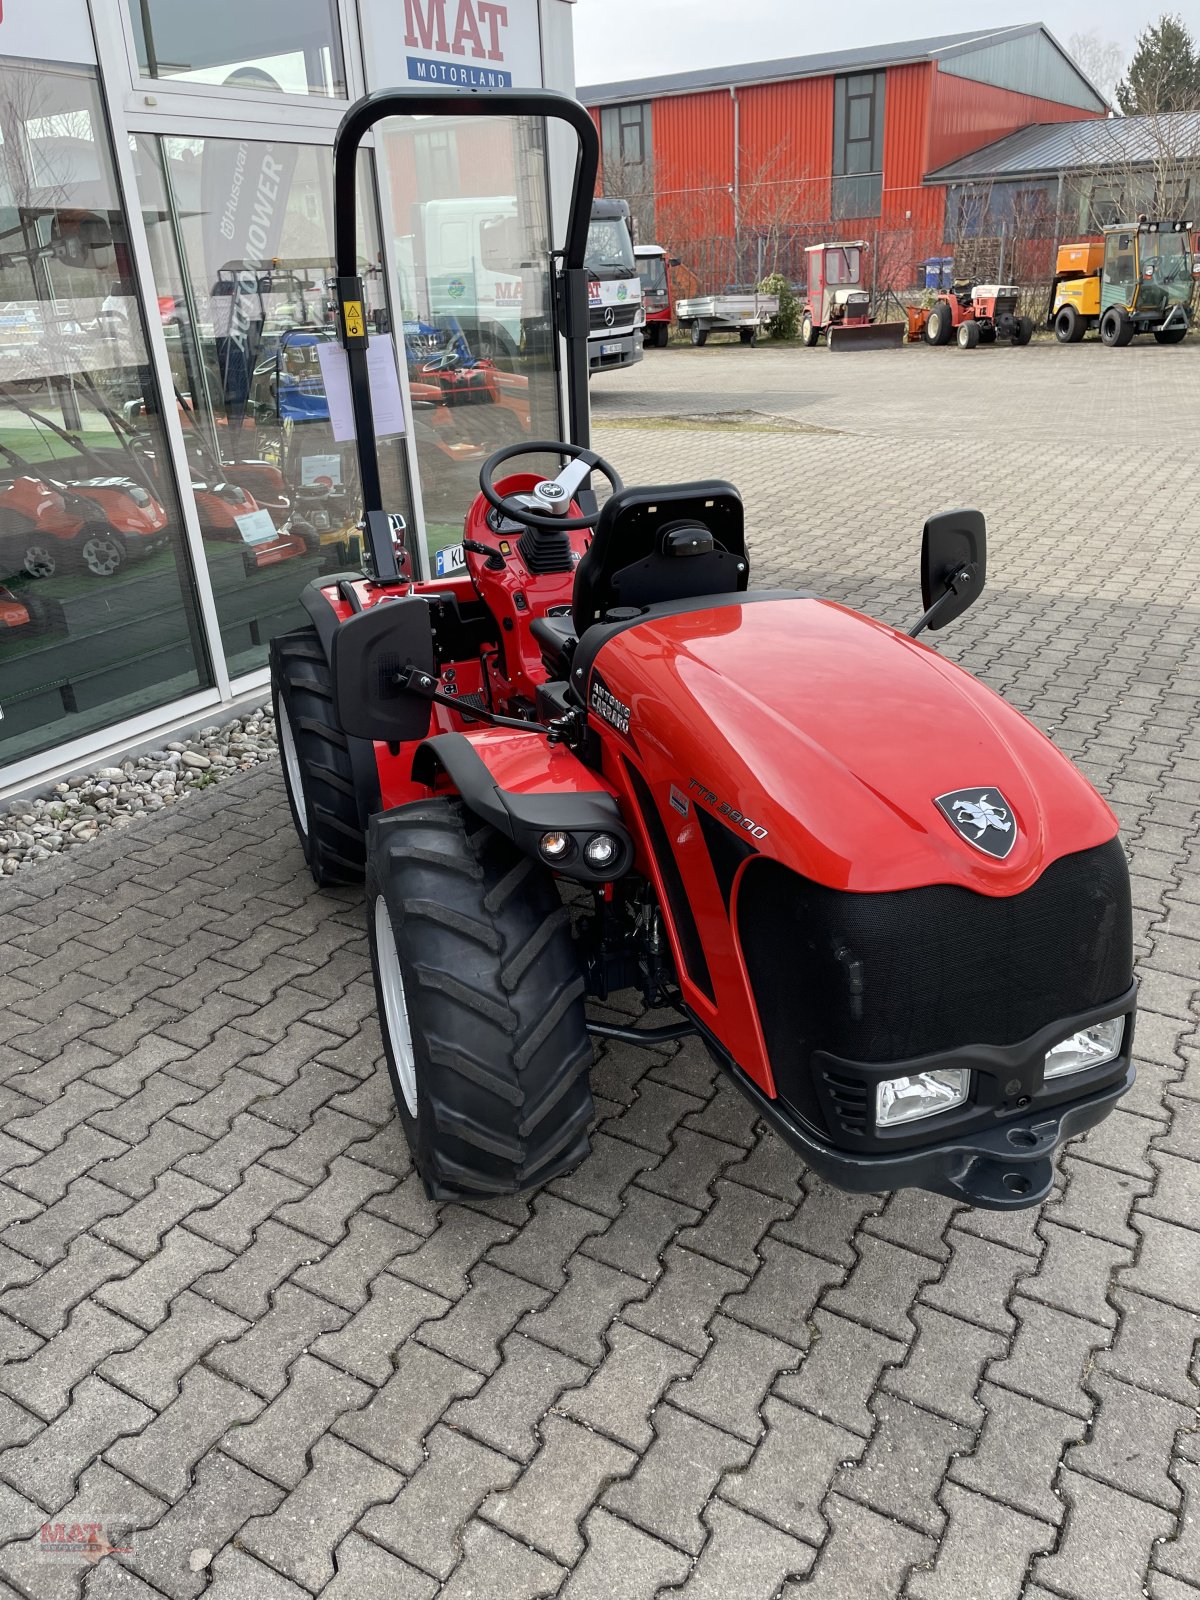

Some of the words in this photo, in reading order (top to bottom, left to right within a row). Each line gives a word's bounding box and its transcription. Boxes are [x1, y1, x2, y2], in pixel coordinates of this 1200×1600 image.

[404, 0, 508, 61] MAT
[417, 62, 504, 88] MOTORLAND
[591, 693, 629, 735] CARRARO
[592, 682, 631, 719] ANTONIO
[687, 778, 717, 806] TTR
[717, 801, 769, 840] 3800
